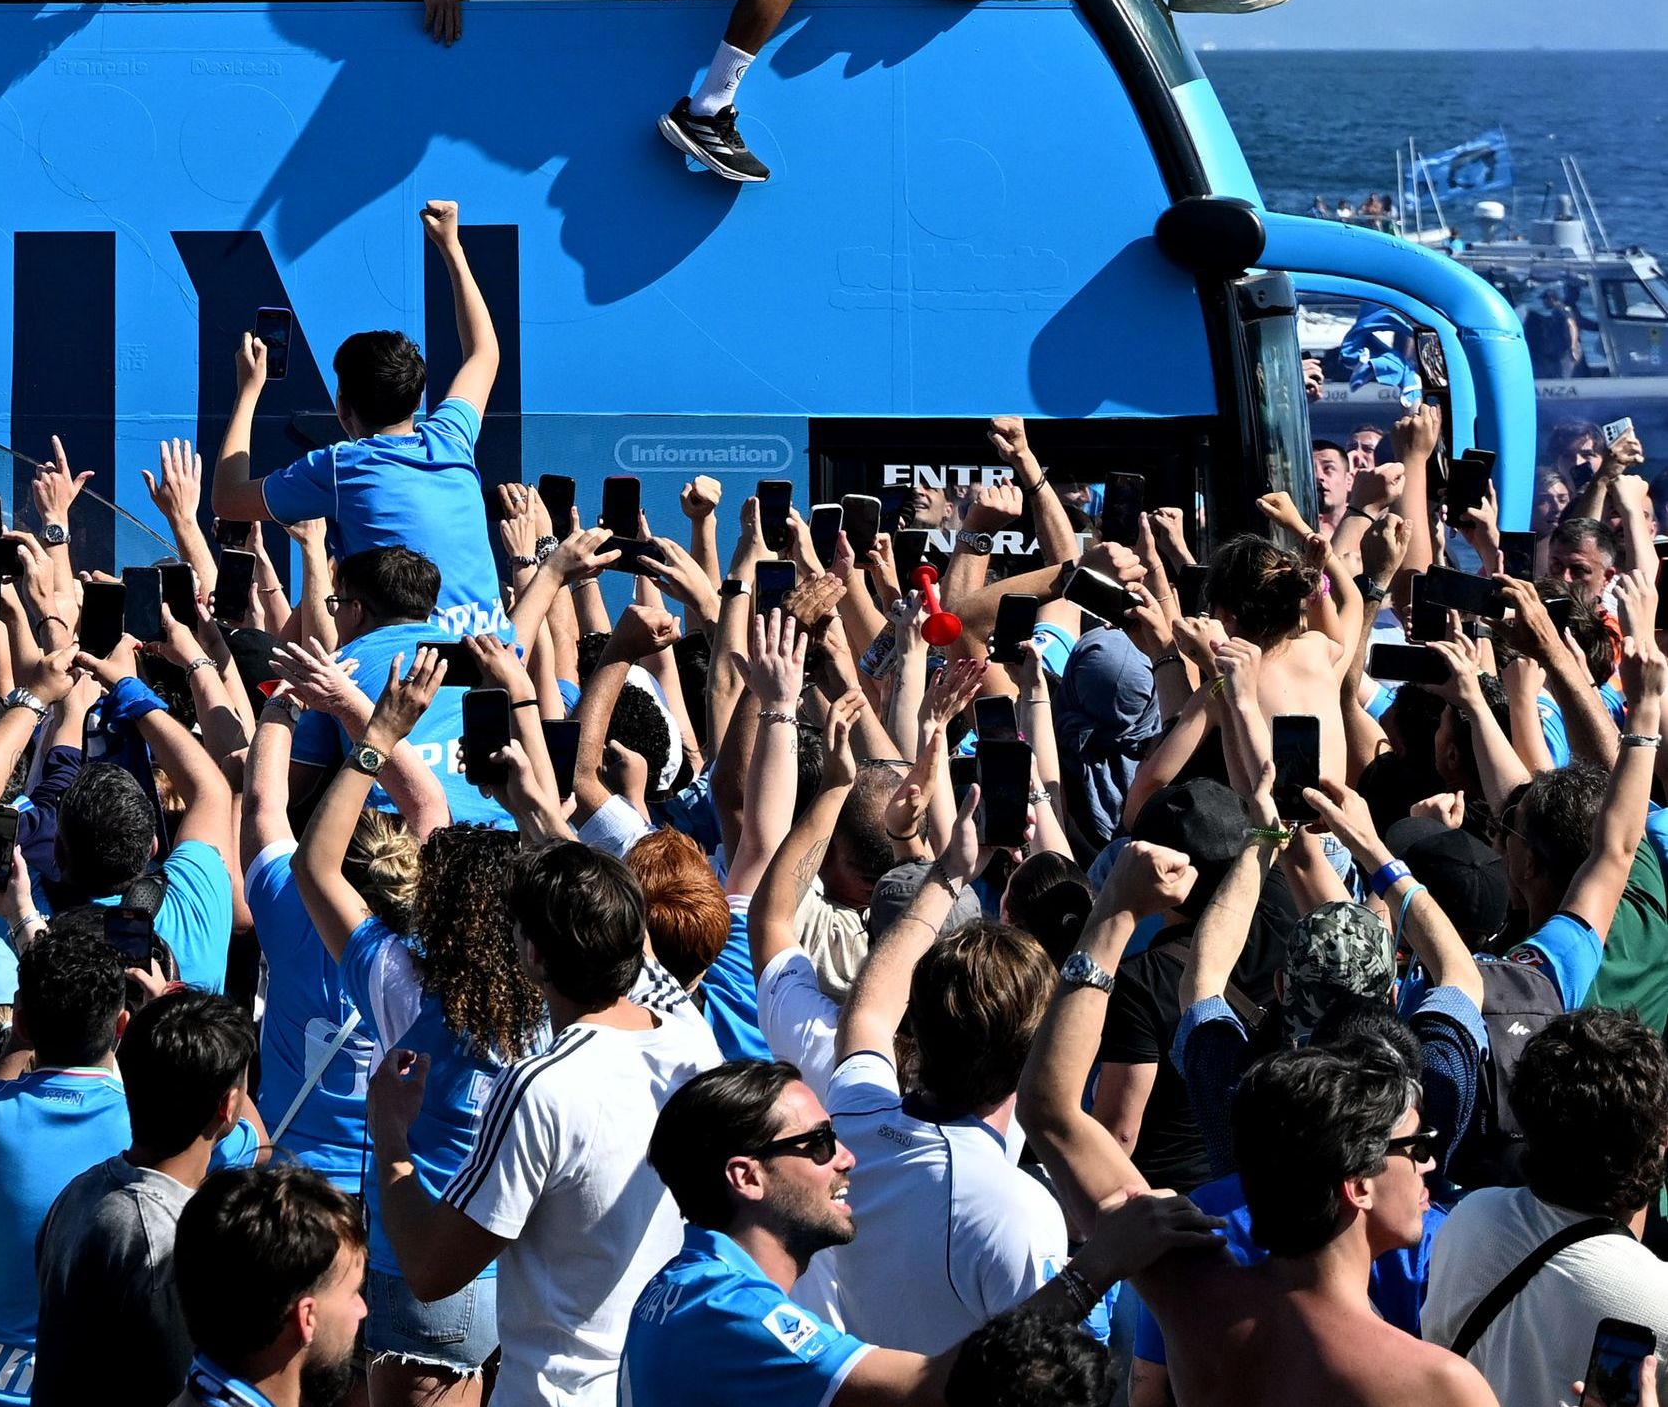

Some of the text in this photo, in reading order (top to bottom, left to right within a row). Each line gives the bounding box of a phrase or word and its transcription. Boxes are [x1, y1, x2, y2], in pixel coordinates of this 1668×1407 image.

[631, 443, 778, 464] Information
[883, 463, 1047, 488] ENTR
[45, 1089, 85, 1106] SSCN
[877, 1123, 912, 1148] SSCN
